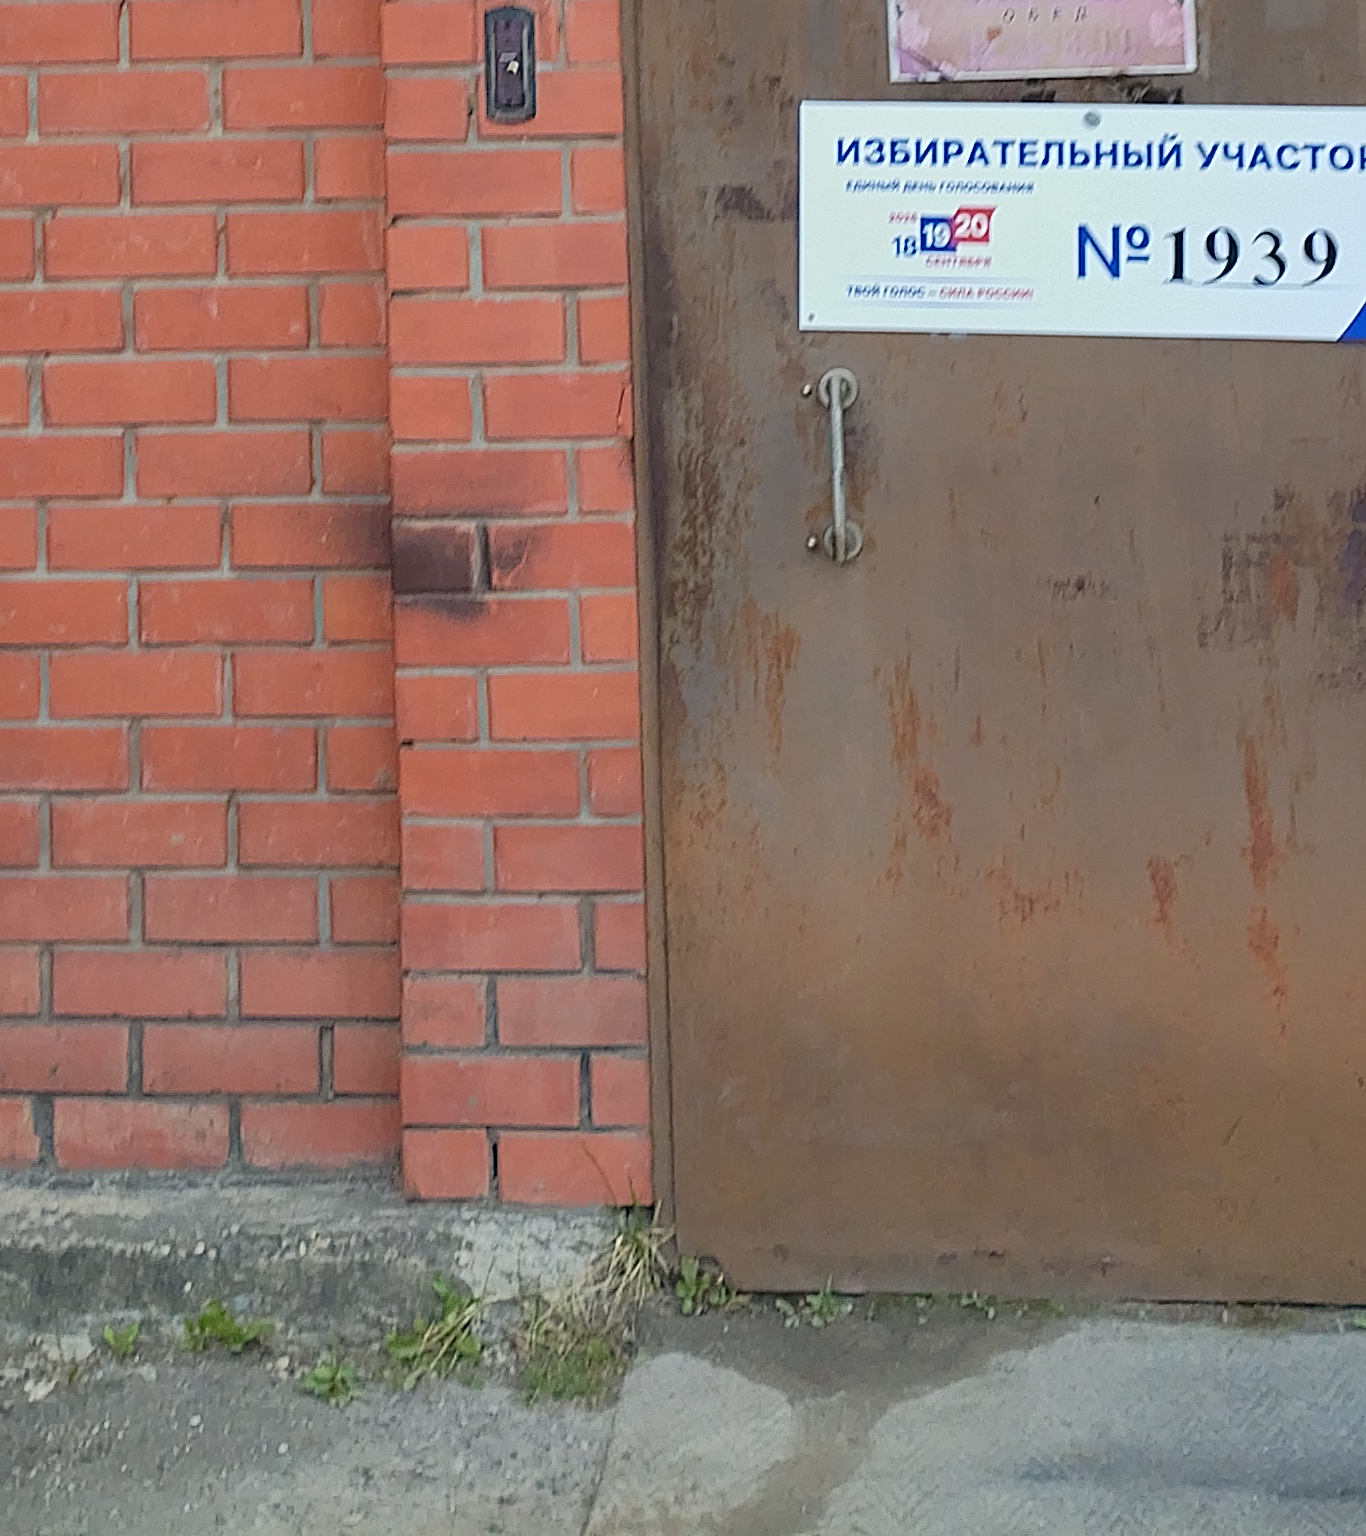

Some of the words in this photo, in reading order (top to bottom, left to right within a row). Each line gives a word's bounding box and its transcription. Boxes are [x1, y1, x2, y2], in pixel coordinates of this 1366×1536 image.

[835, 133, 1183, 170] ИЗБИРАТЕЛЬНЫЙ
[938, 180, 1035, 194] ГОЛОСОВАНИЯ
[892, 235, 917, 257] 18
[922, 221, 952, 249] 19
[954, 212, 989, 239] 20
[883, 285, 927, 299] ГОЛОС
[938, 285, 974, 300] СИЛА
